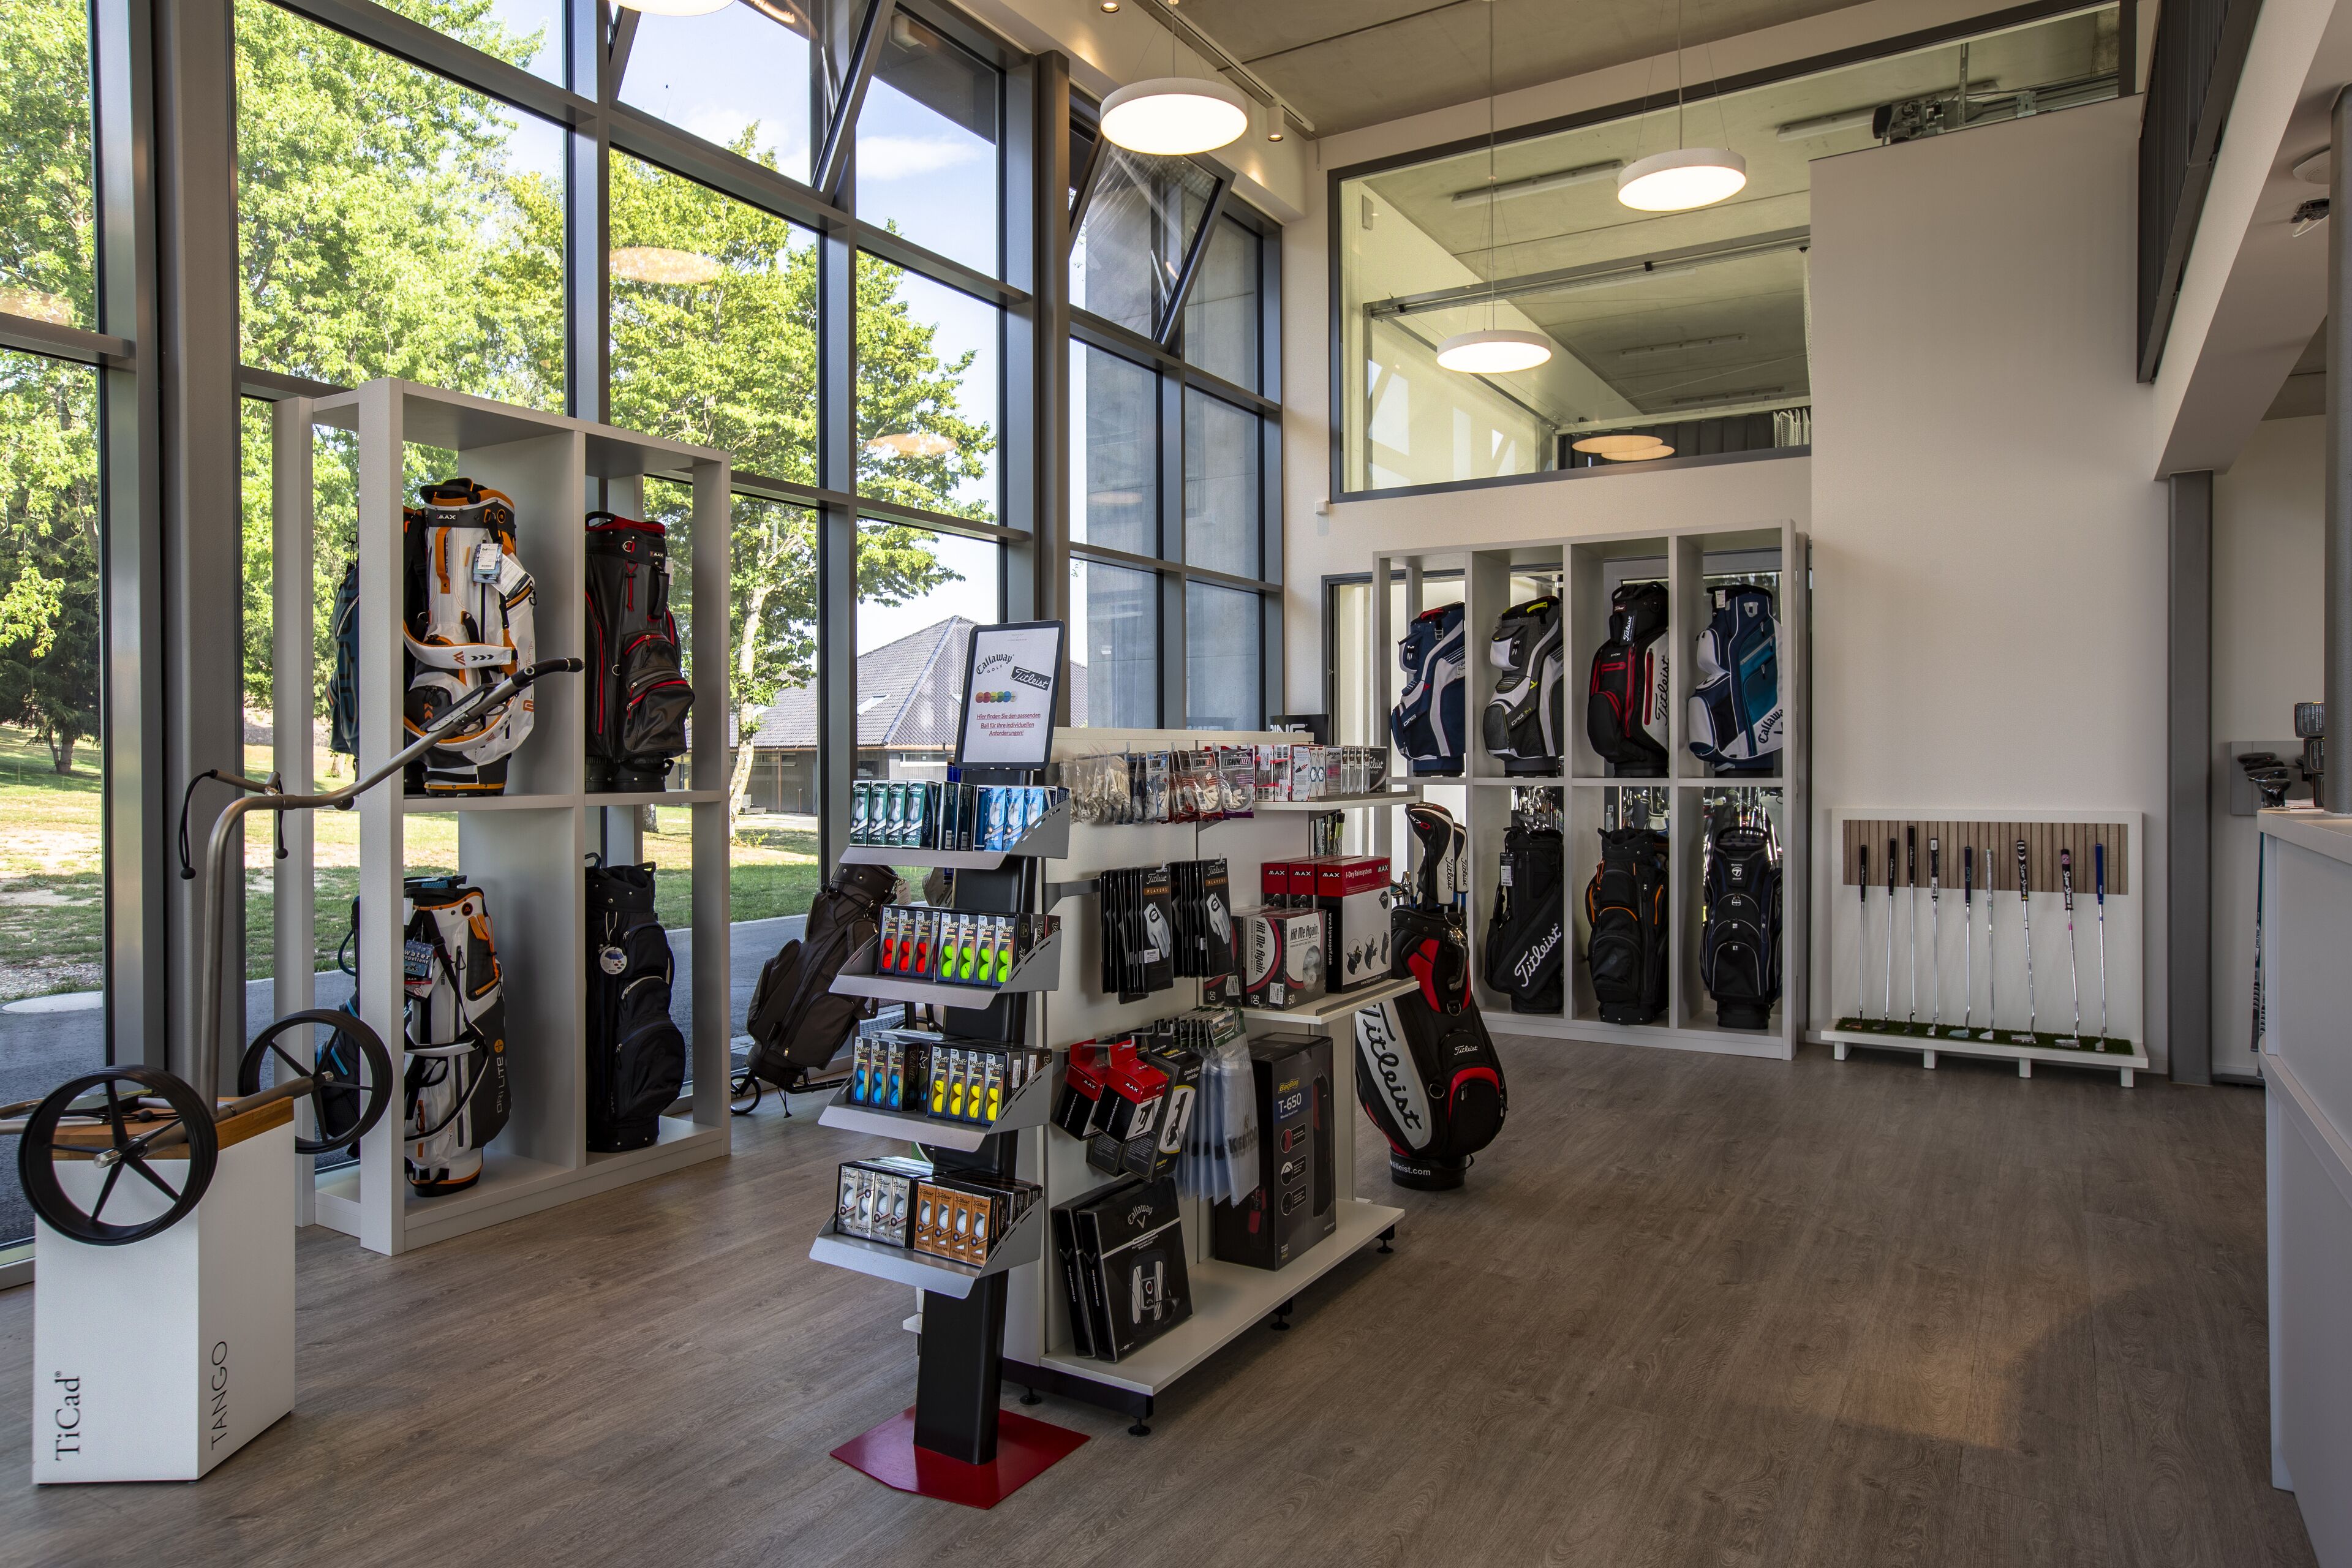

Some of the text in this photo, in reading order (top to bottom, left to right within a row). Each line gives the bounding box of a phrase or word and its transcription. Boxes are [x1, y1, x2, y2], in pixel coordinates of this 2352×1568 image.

[1623, 616, 1632, 642] Titleist
[976, 654, 1014, 675] Callaway
[987, 664, 1003, 674] GOLF
[1011, 668, 1049, 688] Titleist
[1655, 658, 1669, 726] Titleist
[1758, 709, 1783, 744] Callawa
[1207, 865, 1225, 876] Titleist
[1446, 857, 1454, 891] Titleist
[1147, 873, 1167, 884] Titleist
[960, 921, 977, 930] Volvik
[1298, 927, 1305, 939] Me
[1306, 924, 1318, 939] Again
[1254, 921, 1265, 974] Hit Me Again
[404, 956, 429, 964] epellent
[1514, 924, 1562, 987] Titleist
[1210, 990, 1216, 1001] 50
[1253, 995, 1259, 1005] 50
[1288, 994, 1295, 1005] 50
[1453, 1044, 1478, 1055] Titleist
[1184, 1066, 1200, 1076] Umbrella
[1359, 1002, 1422, 1129] Titleist
[1083, 1079, 1096, 1090] MAX
[1125, 1082, 1139, 1093] MAX
[1279, 1079, 1299, 1093] BagBoy
[1278, 1092, 1302, 1113] T-650
[1128, 1205, 1153, 1225] Callaway
[211, 1340, 228, 1450] TANGO
